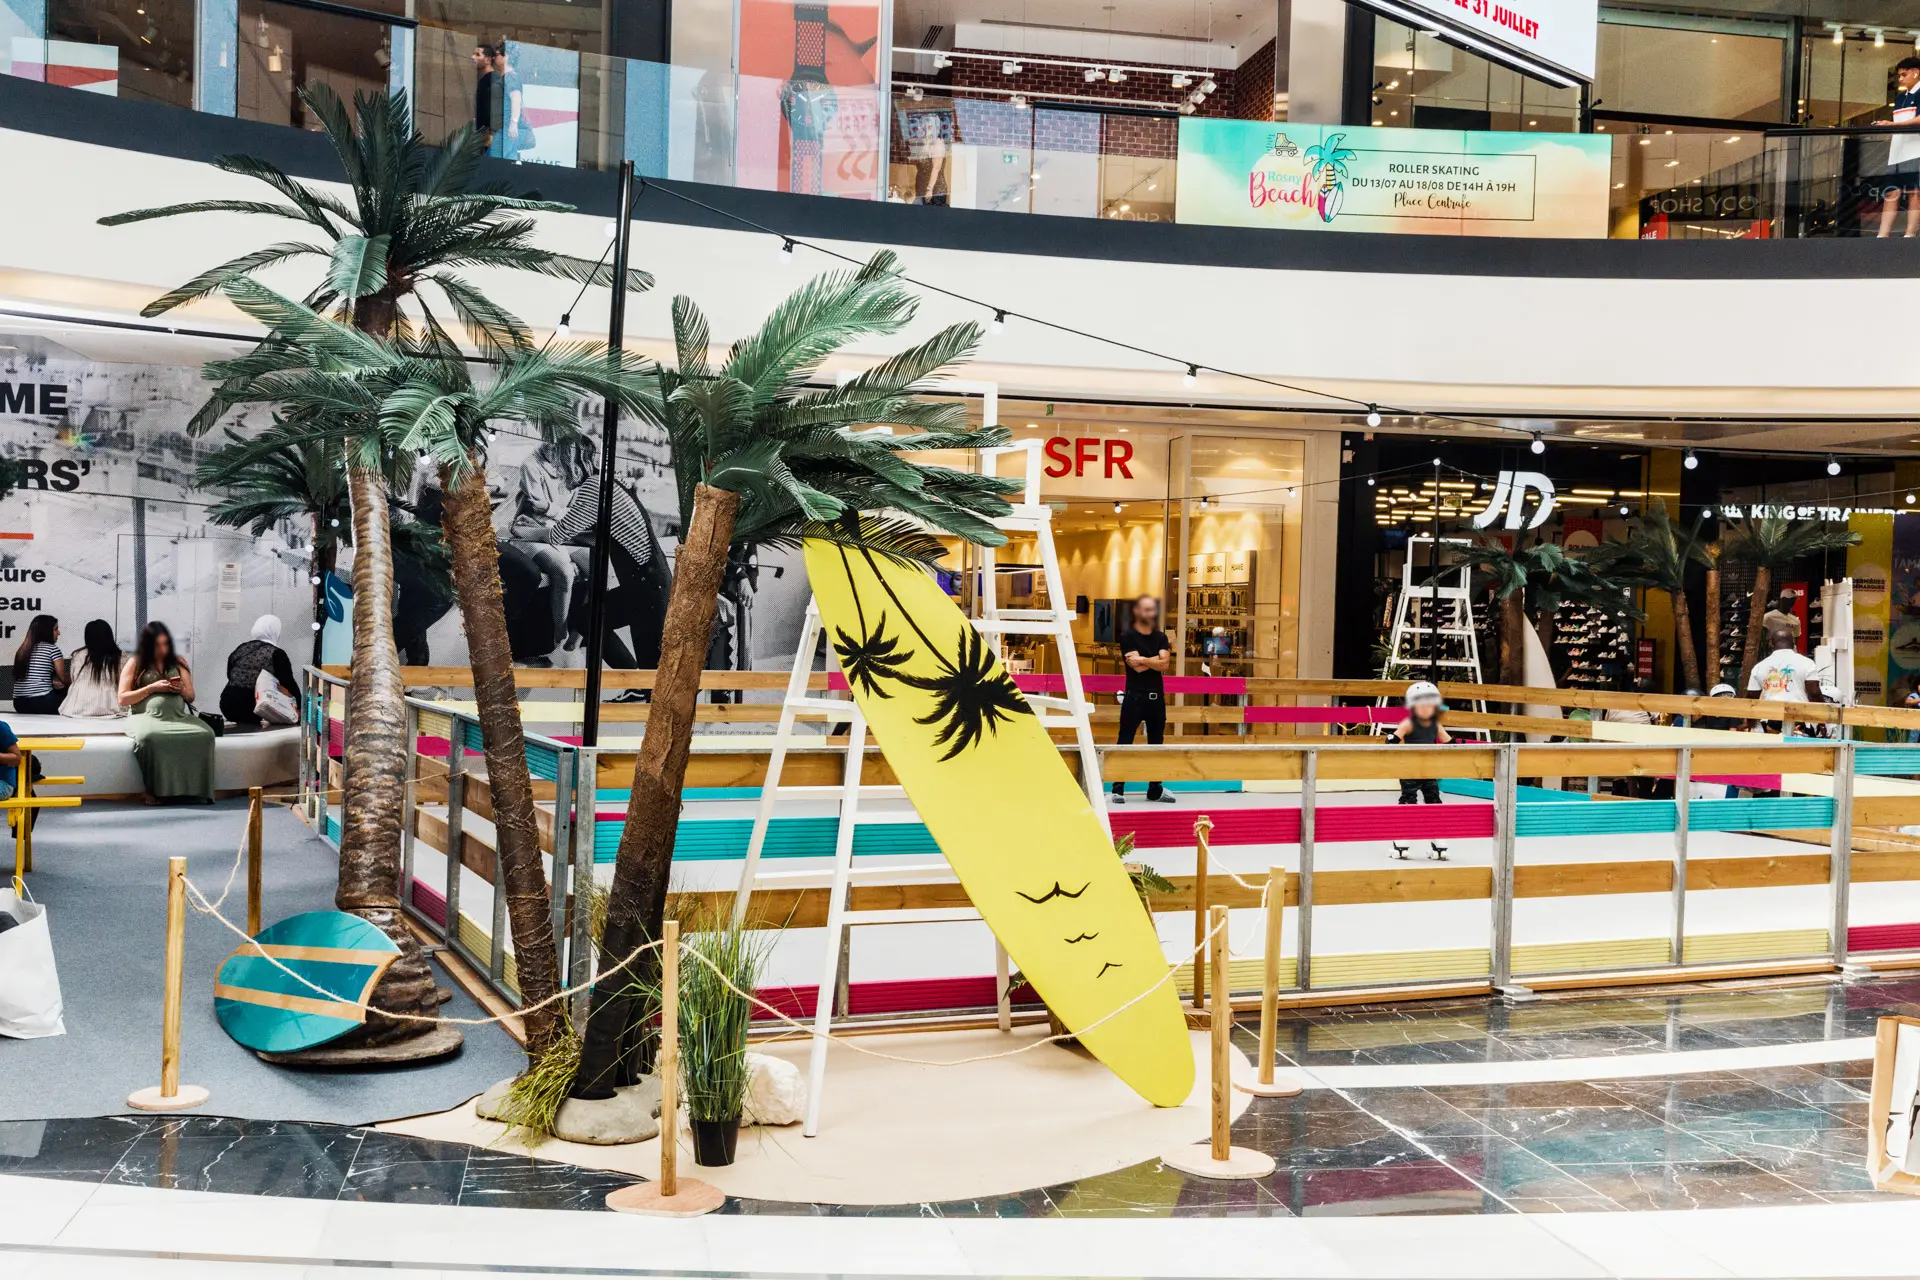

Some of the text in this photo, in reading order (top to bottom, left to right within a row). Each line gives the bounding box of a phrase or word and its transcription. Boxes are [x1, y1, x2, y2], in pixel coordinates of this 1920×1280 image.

[1472, 0, 1488, 18] 31
[1492, 5, 1539, 40] JUILLET
[1268, 171, 1302, 185] Rosny
[1389, 163, 1480, 176] ROLLER SKATING
[1249, 171, 1318, 208] Beach
[1352, 177, 1516, 192] DU 13/07 AU 18/08 DE 14H À 19H
[1394, 192, 1471, 210] Place Centrale
[1641, 229, 1657, 239] SALE
[0, 382, 68, 416] ME
[1044, 436, 1134, 479] SFR
[1473, 470, 1555, 530] JD
[1751, 504, 1795, 520] KING
